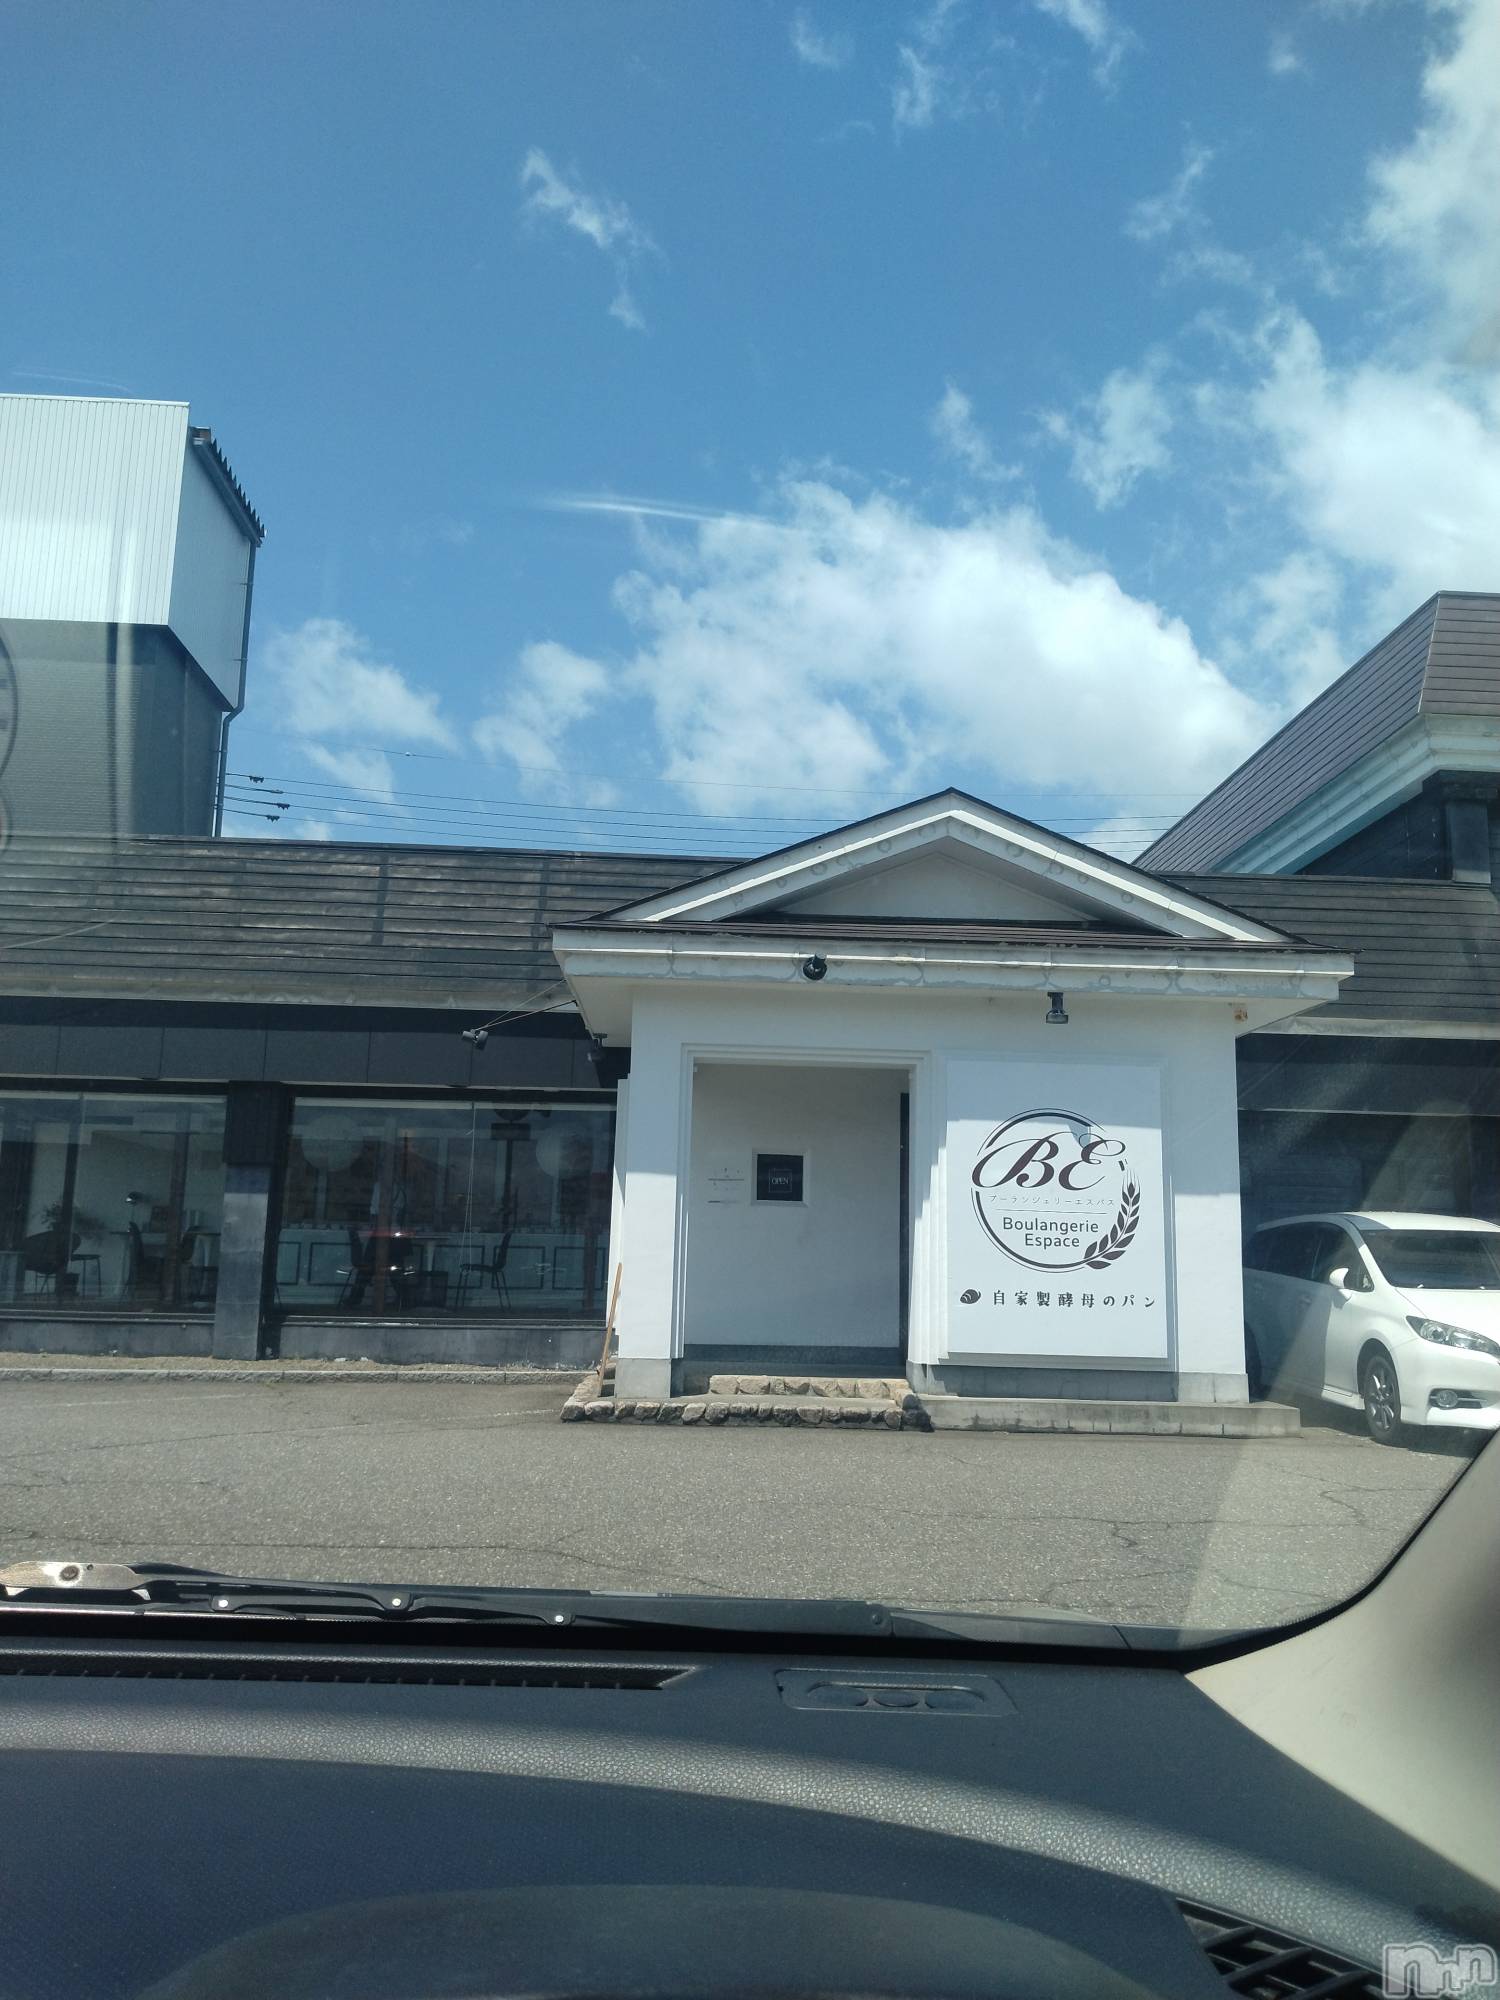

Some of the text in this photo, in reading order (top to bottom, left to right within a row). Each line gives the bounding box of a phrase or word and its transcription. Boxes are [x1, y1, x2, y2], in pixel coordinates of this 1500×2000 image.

[972, 1131, 1126, 1191] BE
[771, 1176, 790, 1185] OPEN
[1003, 1217, 1099, 1235] Boulangerie
[1025, 1233, 1080, 1249] Espace
[993, 1290, 1156, 1309] 自家製酵母のパン
